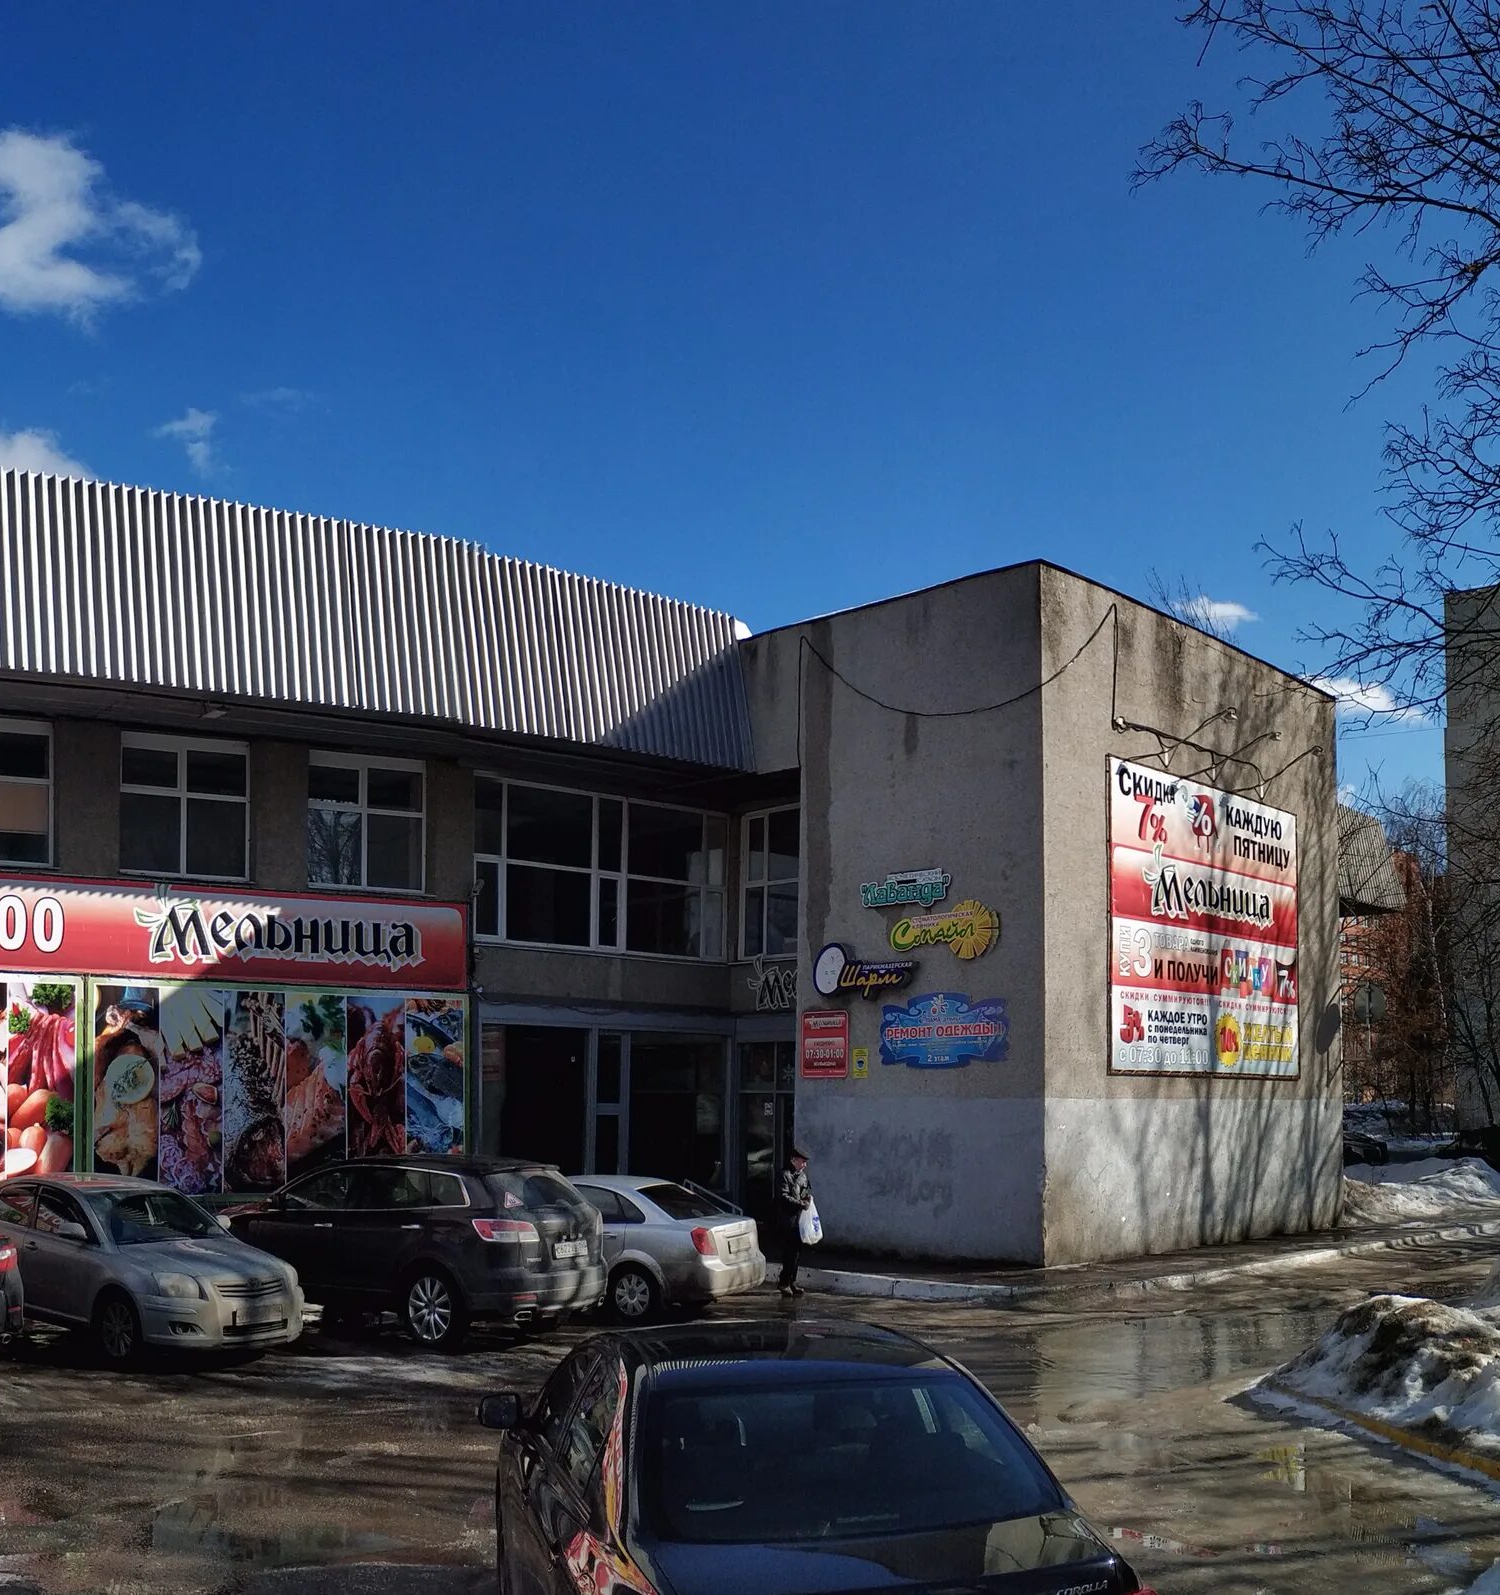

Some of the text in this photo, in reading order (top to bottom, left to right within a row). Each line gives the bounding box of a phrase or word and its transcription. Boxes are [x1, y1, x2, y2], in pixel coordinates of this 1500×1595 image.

[1118, 767, 1176, 805] СКИДКА
[1133, 794, 1169, 844] 7%
[1226, 805, 1282, 840] КАЖДУЮ
[1233, 836, 1290, 871] ПЯТНИЦУ
[1153, 866, 1272, 922] Мельница
[151, 903, 420, 964] Мельница
[1118, 925, 1131, 977] КУПИ
[1133, 929, 1190, 977] 3 ТОВАРА
[840, 964, 903, 997] Шарм
[1154, 959, 1163, 979] И
[1167, 960, 1219, 986] ПОЛУЧИ
[1120, 991, 1150, 1001] СКИДКИ
[1147, 1009, 1208, 1026] КАЖДОЕ УТРО
[1154, 1025, 1208, 1036] понедельника
[886, 1026, 933, 1040] РЕМОНТ
[1147, 1035, 1190, 1047] по четверг
[805, 1048, 845, 1059] 07:30-01:00
[927, 1054, 932, 1062] 2
[1129, 1046, 1162, 1063] 07:30
[1164, 1052, 1177, 1066] до
[1179, 1048, 1209, 1065] 11:00
